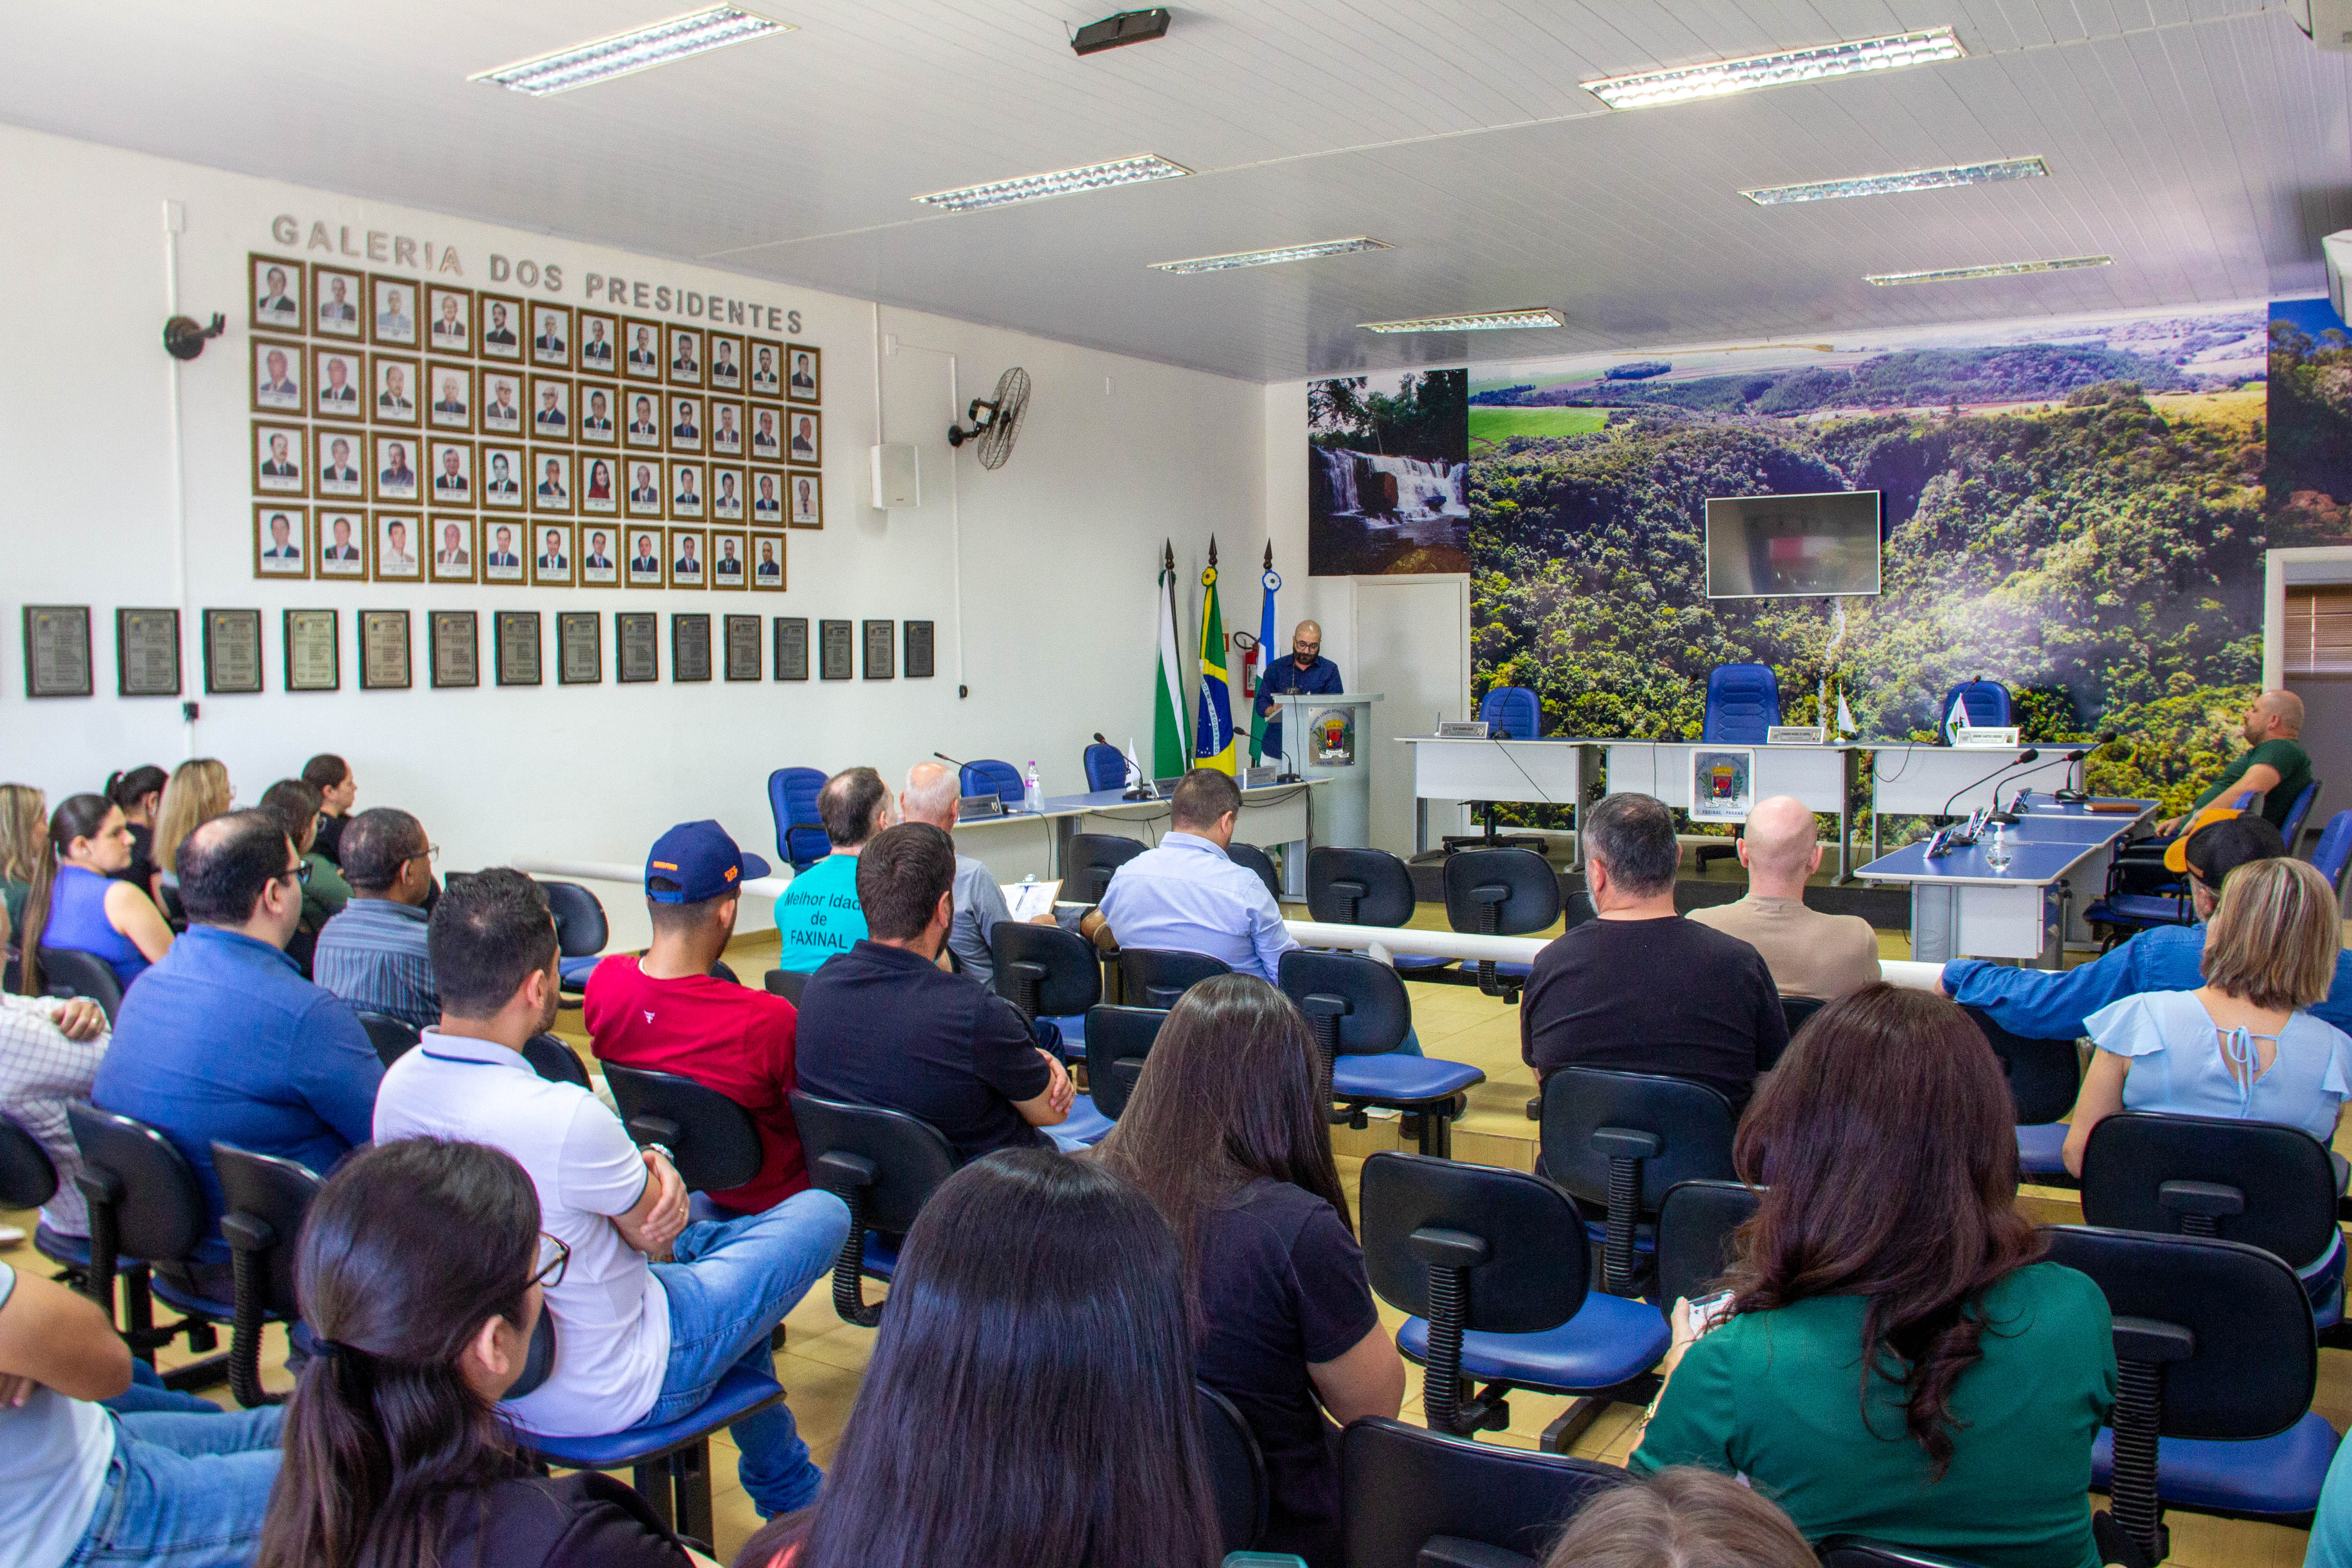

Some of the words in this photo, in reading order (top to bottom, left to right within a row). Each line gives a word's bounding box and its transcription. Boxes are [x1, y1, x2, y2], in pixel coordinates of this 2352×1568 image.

[272, 214, 462, 276] GALERIA
[489, 253, 563, 292] DOS
[586, 272, 802, 334] PRESIDENTES
[1210, 710, 1220, 753] PROGRESSO
[784, 891, 826, 906] Melhor
[811, 911, 827, 926] de
[791, 930, 848, 949] FAXINAL
